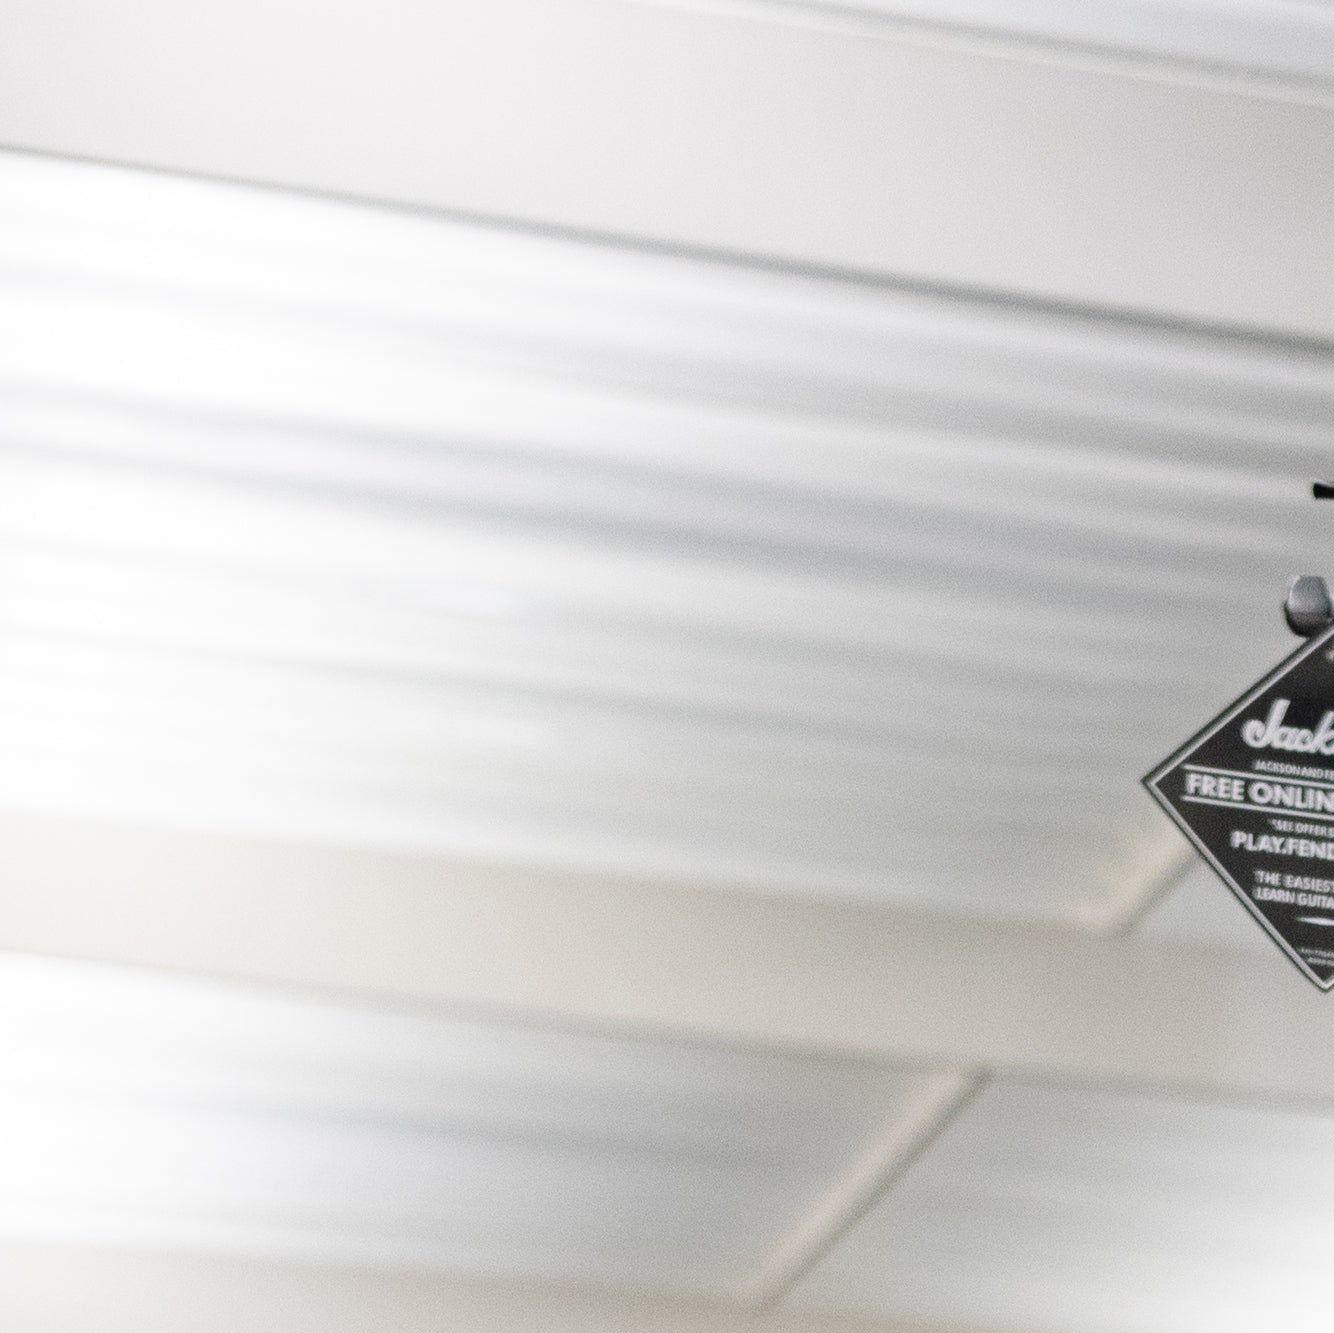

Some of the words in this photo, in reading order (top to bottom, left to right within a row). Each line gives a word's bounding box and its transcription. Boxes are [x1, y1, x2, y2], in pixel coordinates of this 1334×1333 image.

[1185, 773, 1246, 801] FREE
[1254, 870, 1282, 885] THE
[1254, 887, 1296, 904] LEARN
